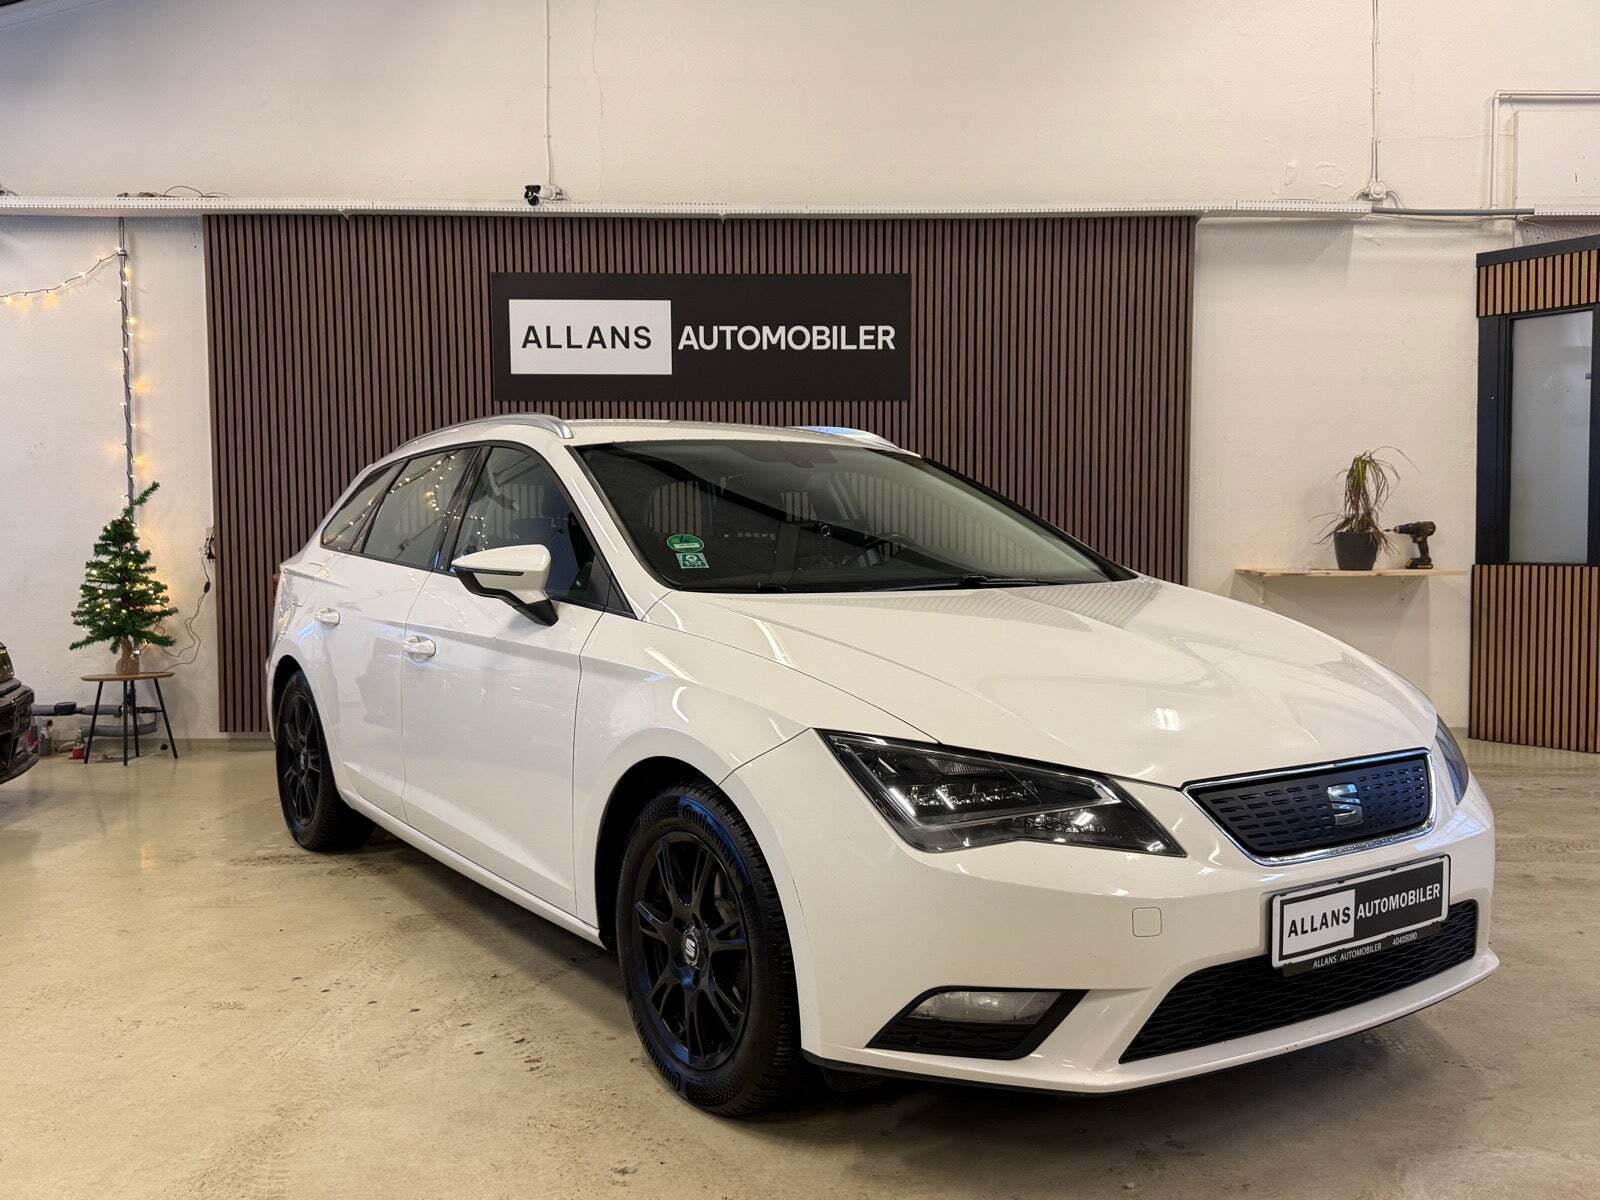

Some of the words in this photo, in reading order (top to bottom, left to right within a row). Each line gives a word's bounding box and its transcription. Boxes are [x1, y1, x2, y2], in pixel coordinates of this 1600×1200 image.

[521, 324, 652, 350] ALLANS
[677, 324, 896, 351] AUTOMOBILER
[1287, 906, 1351, 938] ALLANS
[1356, 883, 1440, 920] AUTOMOBILER
[1312, 954, 1337, 969] ALLANS
[1339, 942, 1382, 961] AUTOMOBILER
